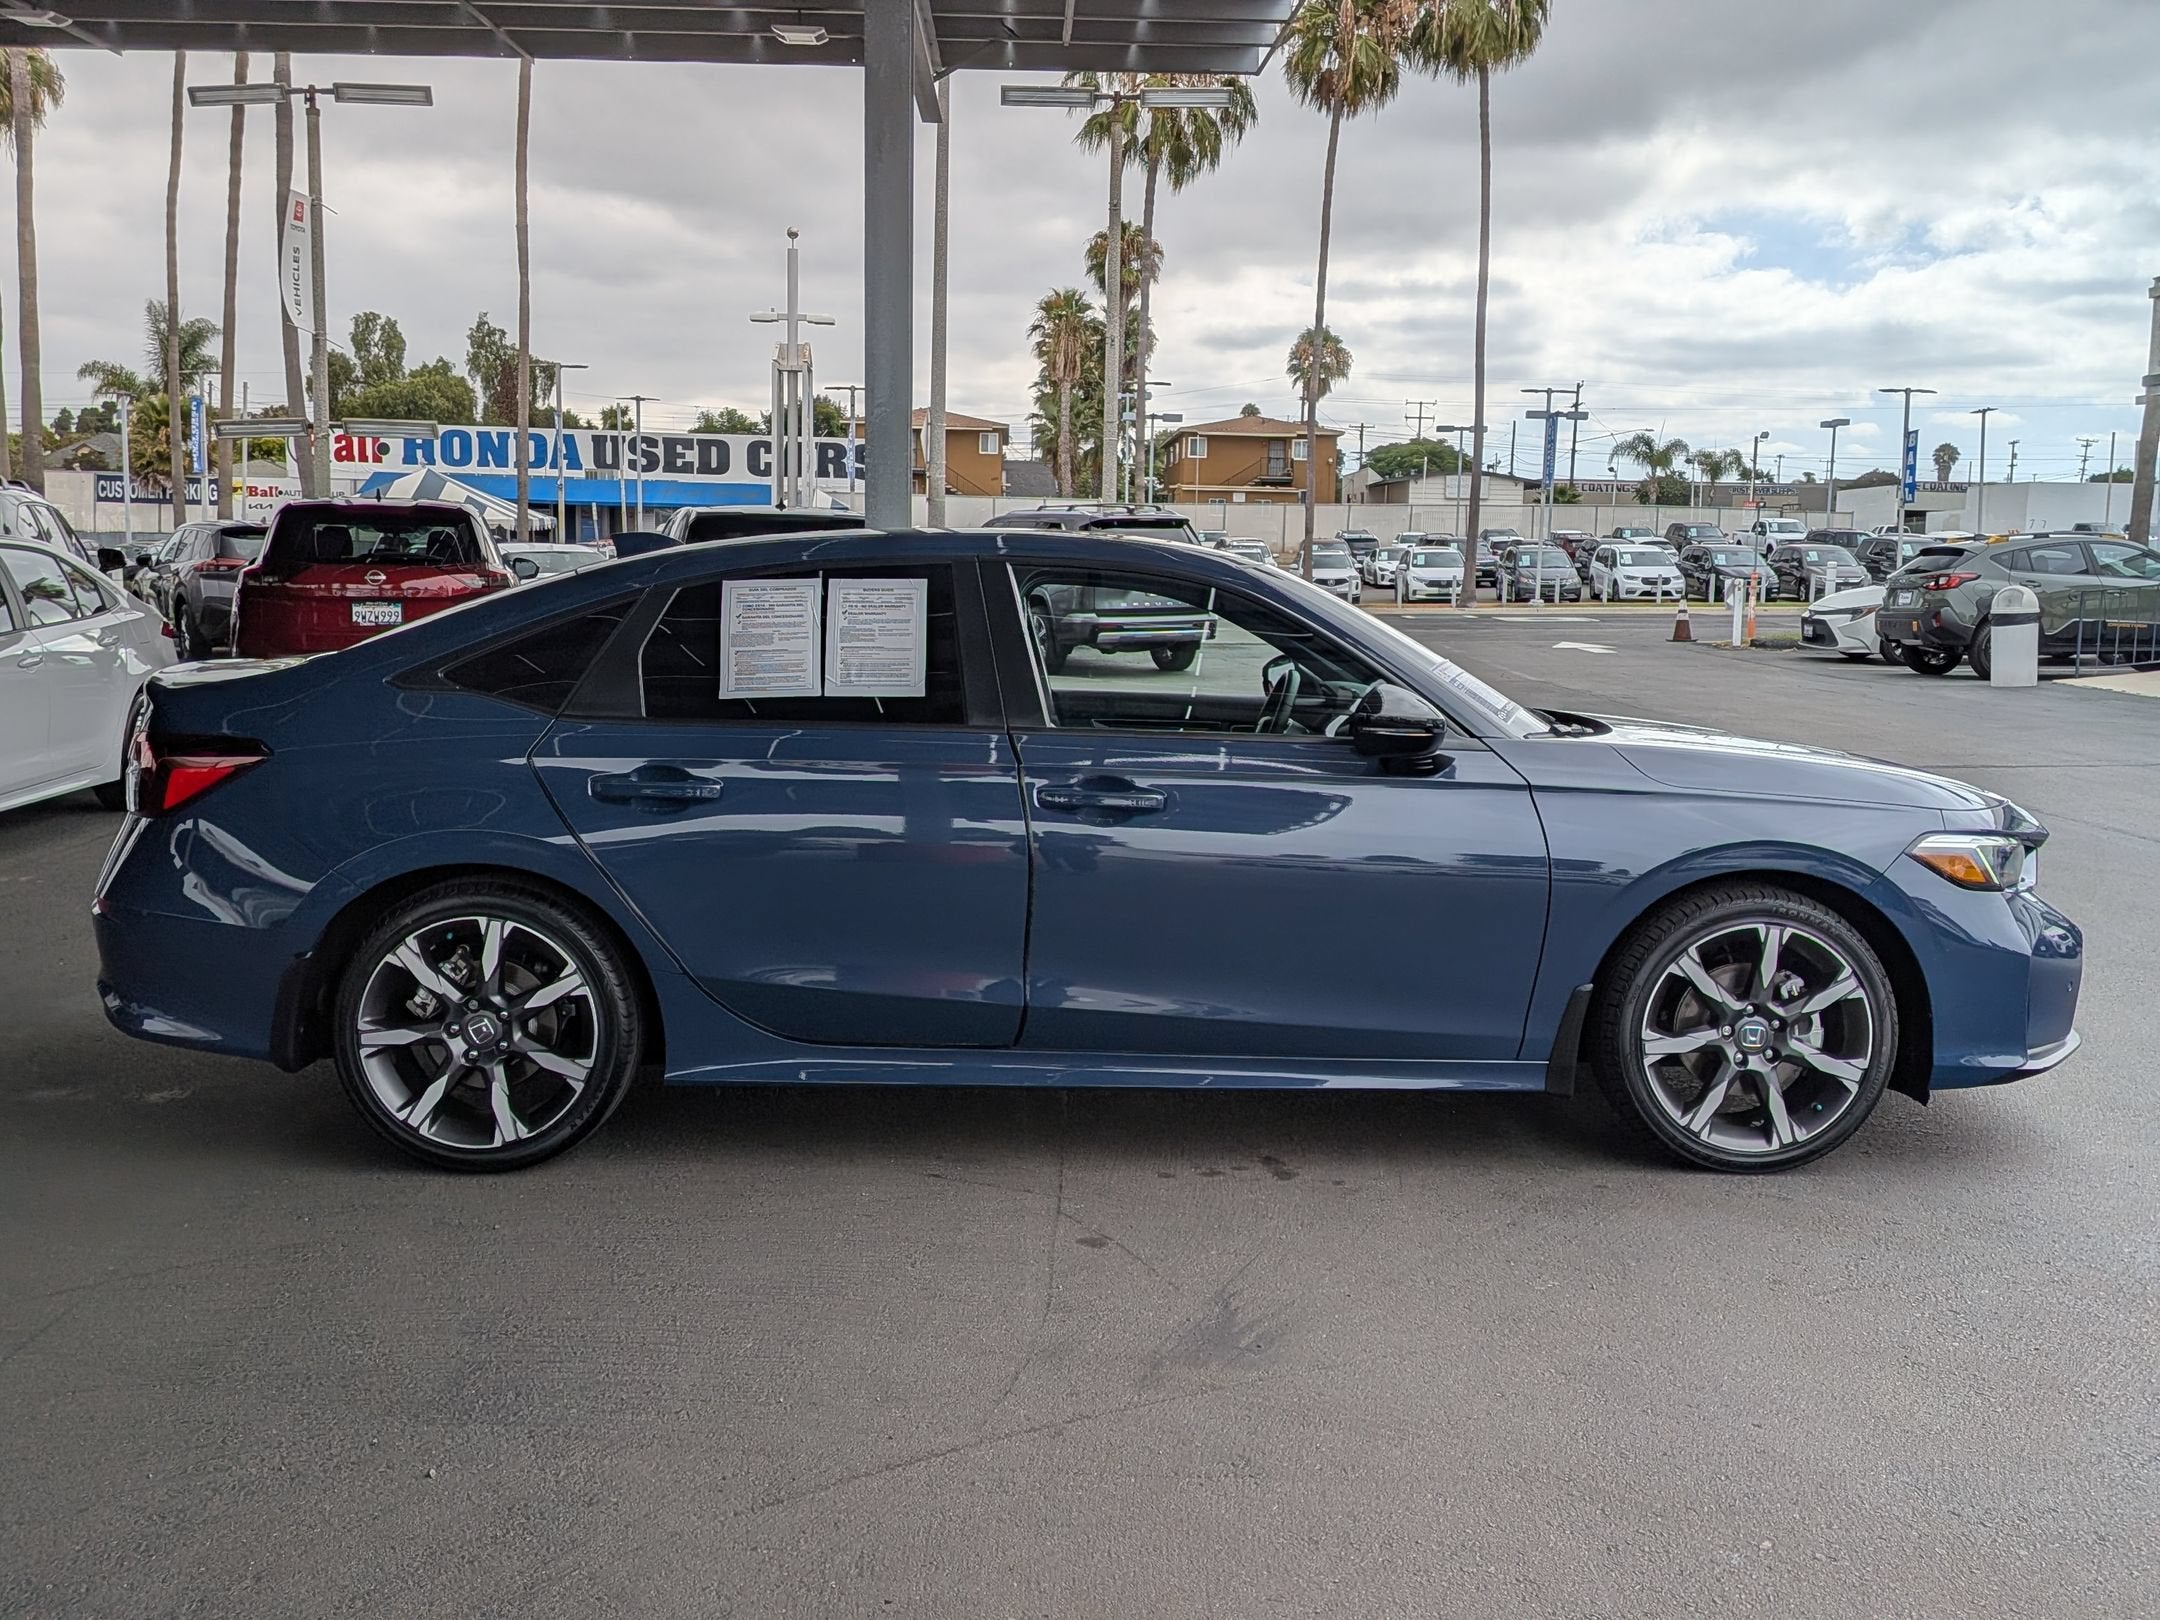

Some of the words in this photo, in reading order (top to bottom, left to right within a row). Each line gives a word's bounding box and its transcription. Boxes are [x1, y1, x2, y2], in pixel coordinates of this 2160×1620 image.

[292, 246, 303, 316] VEHICLES
[402, 429, 583, 470] HONDA
[591, 434, 731, 475] USED
[746, 439, 866, 481] CR
[1904, 433, 1916, 501] BALL
[246, 485, 280, 498] Ball
[283, 489, 304, 497] AUT
[1581, 482, 1638, 493] COATINGS
